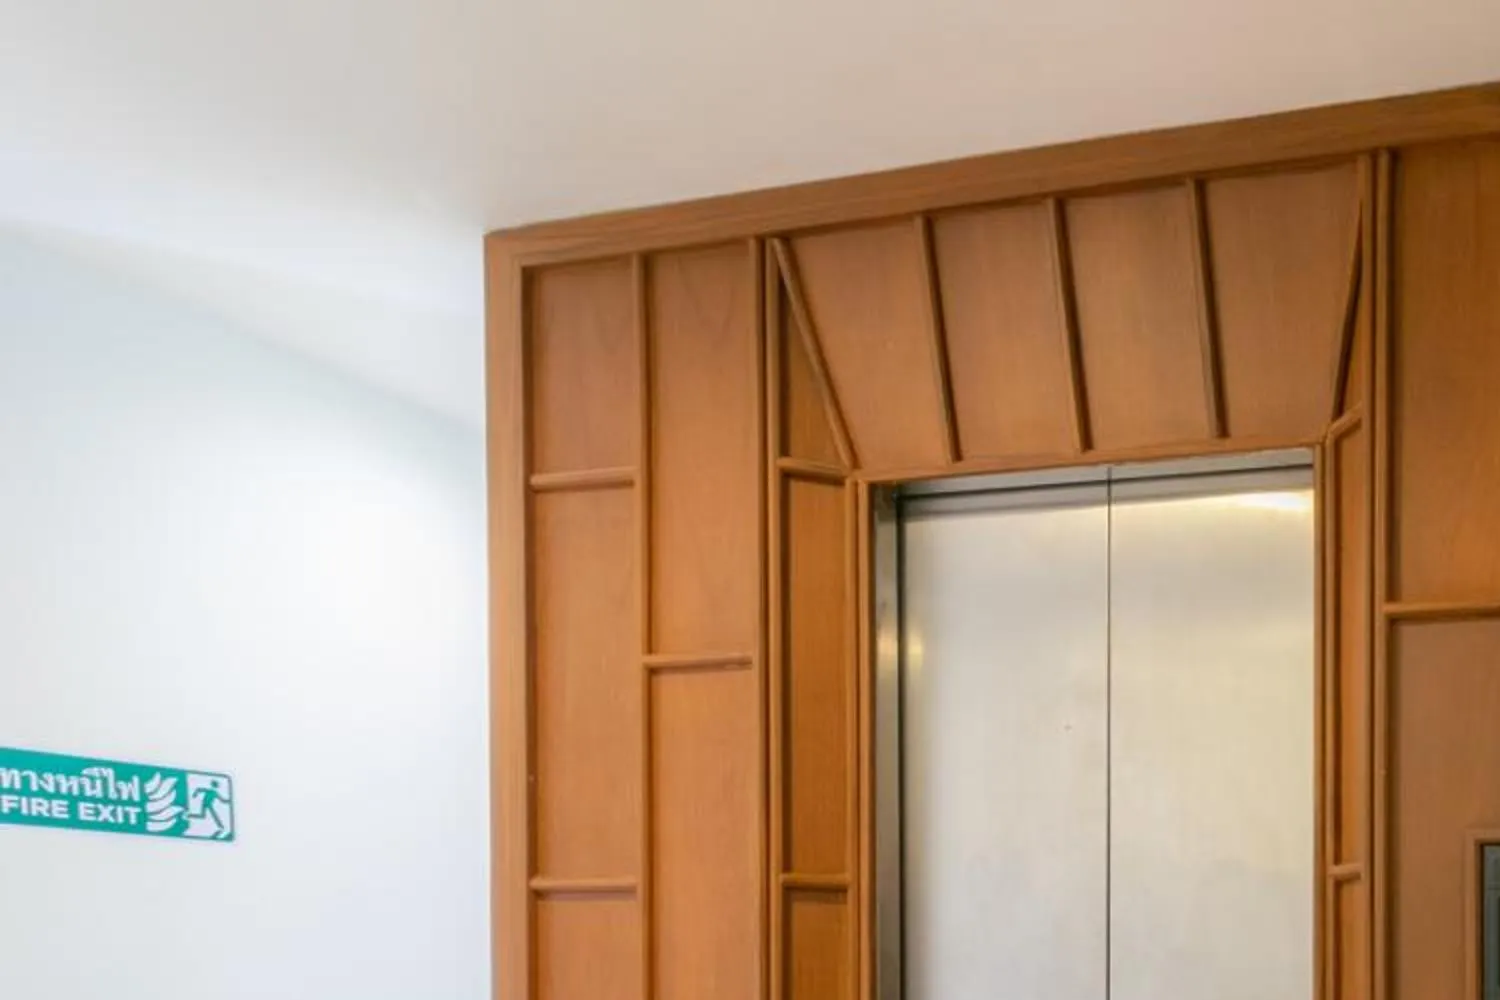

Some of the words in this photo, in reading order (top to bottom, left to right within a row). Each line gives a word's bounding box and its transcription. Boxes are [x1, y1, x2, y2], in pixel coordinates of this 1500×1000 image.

[0, 766, 141, 802] ทางหนีไฟ
[1, 795, 70, 819] FIRE
[78, 802, 142, 825] EXIT
